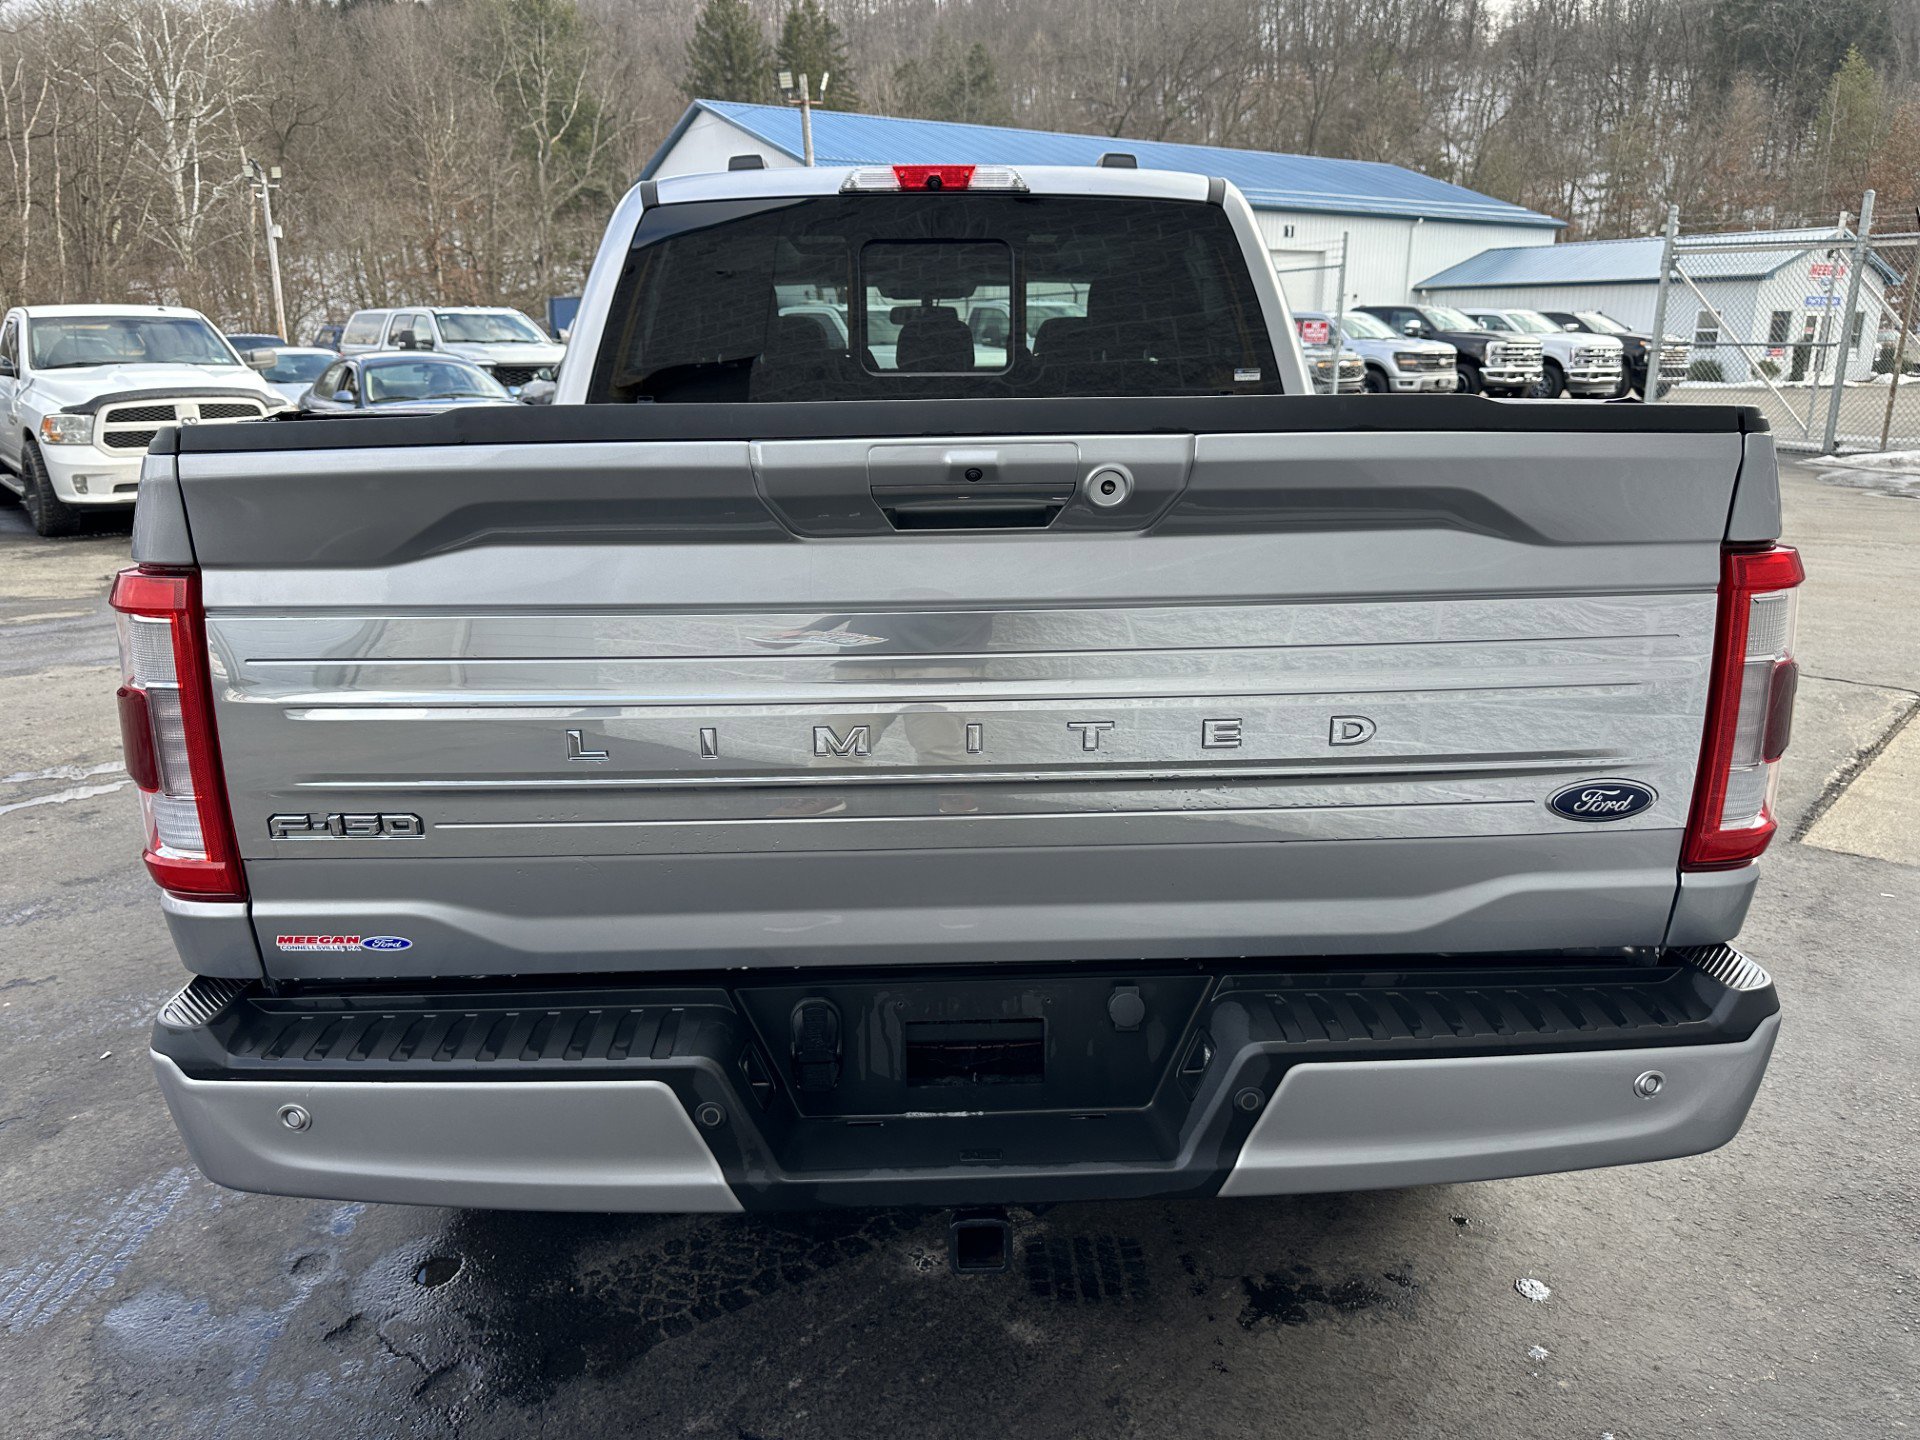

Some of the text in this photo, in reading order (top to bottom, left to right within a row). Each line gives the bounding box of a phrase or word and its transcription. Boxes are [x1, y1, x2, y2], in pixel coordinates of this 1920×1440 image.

[1809, 263, 1846, 276] MEEGN
[566, 715, 1377, 761] LIMITED
[1573, 789, 1634, 812] Ford
[267, 813, 425, 839] F-150
[277, 936, 360, 945] MEEGAN
[372, 939, 402, 948] Ford
